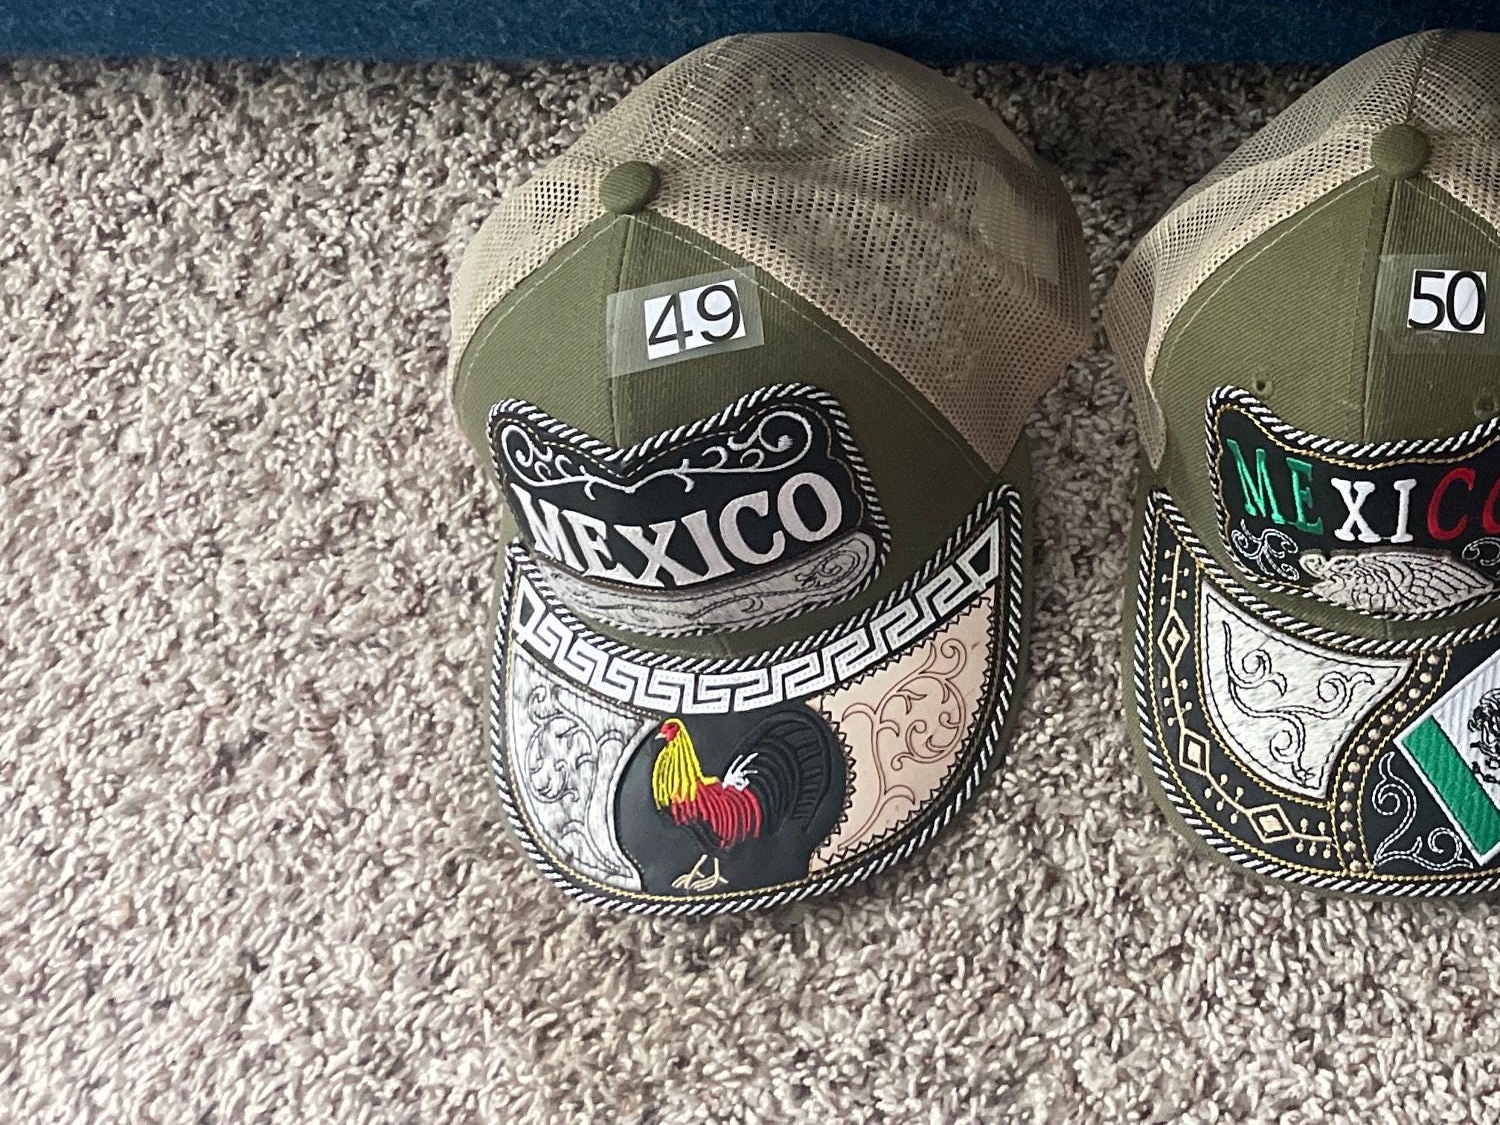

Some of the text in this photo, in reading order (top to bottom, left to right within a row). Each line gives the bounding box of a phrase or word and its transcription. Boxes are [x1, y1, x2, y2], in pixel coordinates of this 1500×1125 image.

[646, 284, 742, 351] 49
[1409, 270, 1486, 333] 50
[510, 472, 843, 589] MEXICO
